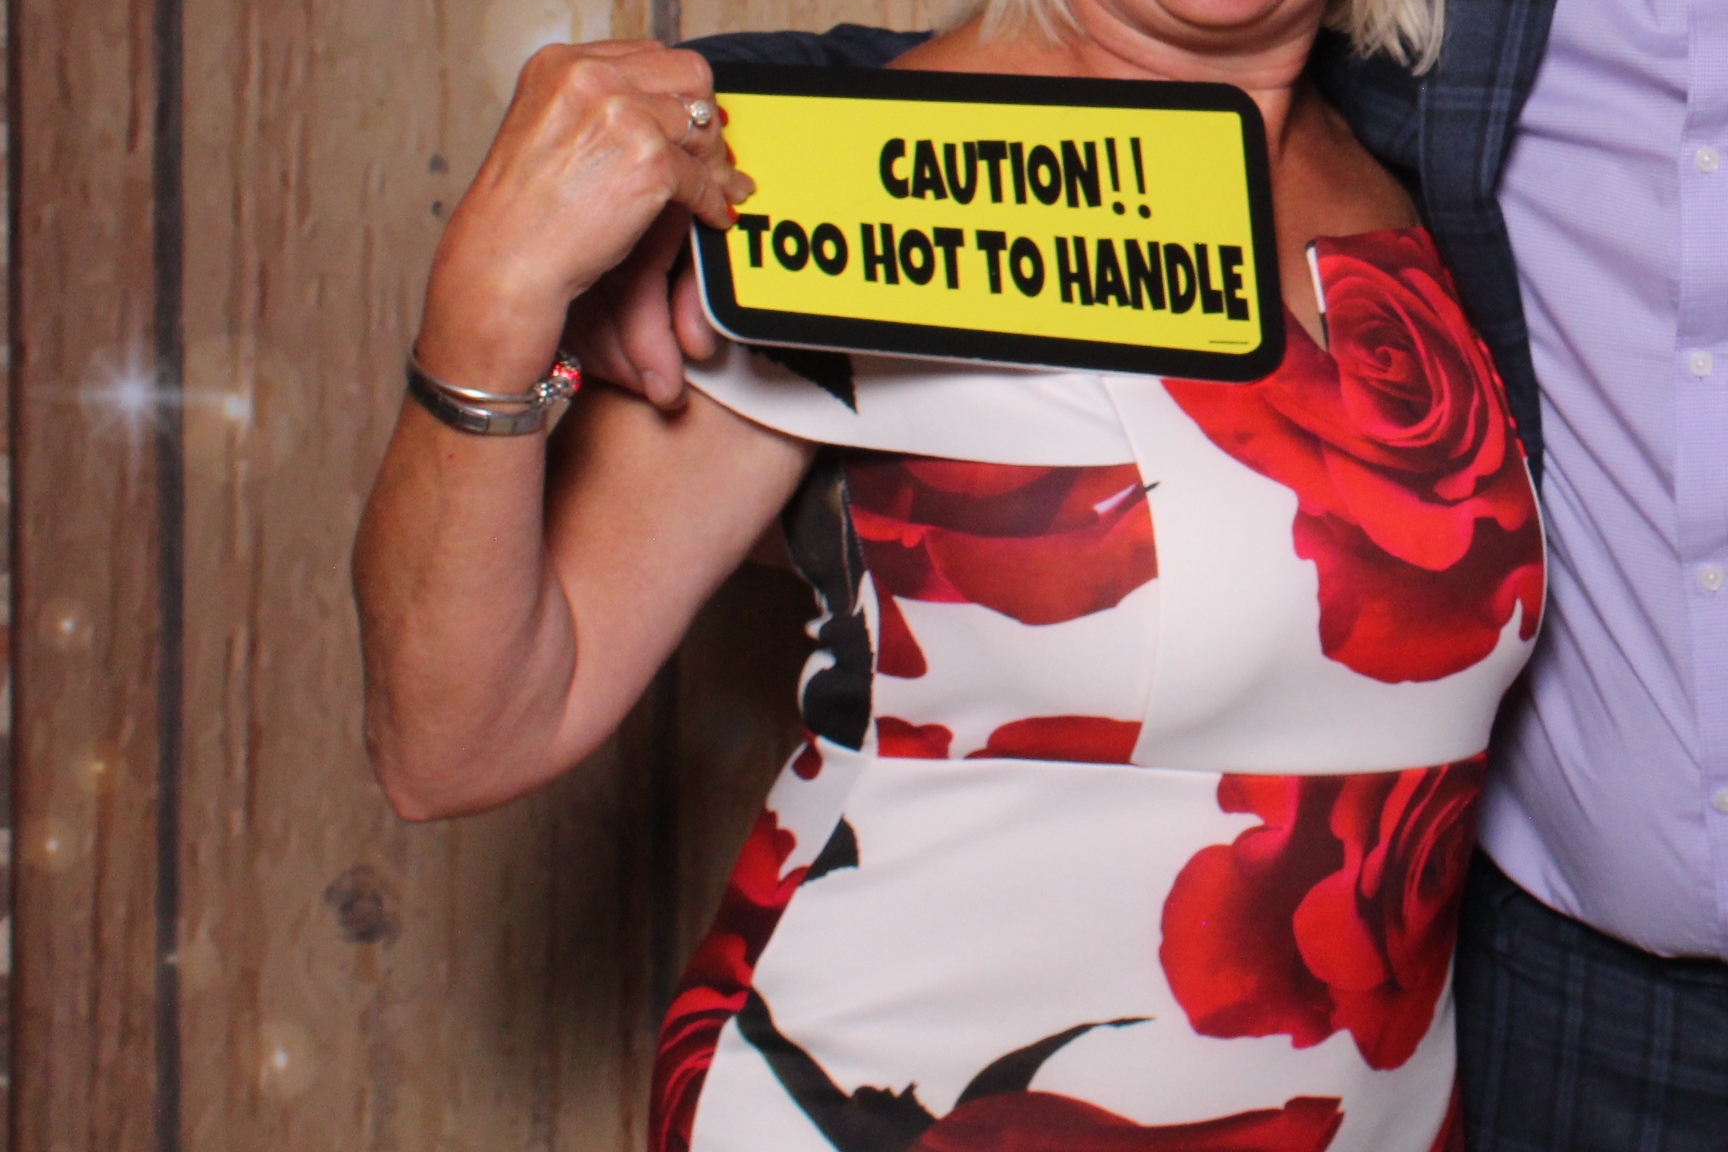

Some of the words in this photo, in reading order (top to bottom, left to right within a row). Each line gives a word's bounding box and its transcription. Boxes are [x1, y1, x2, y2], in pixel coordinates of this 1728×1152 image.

[880, 137, 1151, 219] CAUTION!!
[736, 213, 848, 276] TOO
[861, 223, 964, 290] HOT
[975, 230, 1045, 298] TO
[1054, 235, 1250, 322] HANDLE
